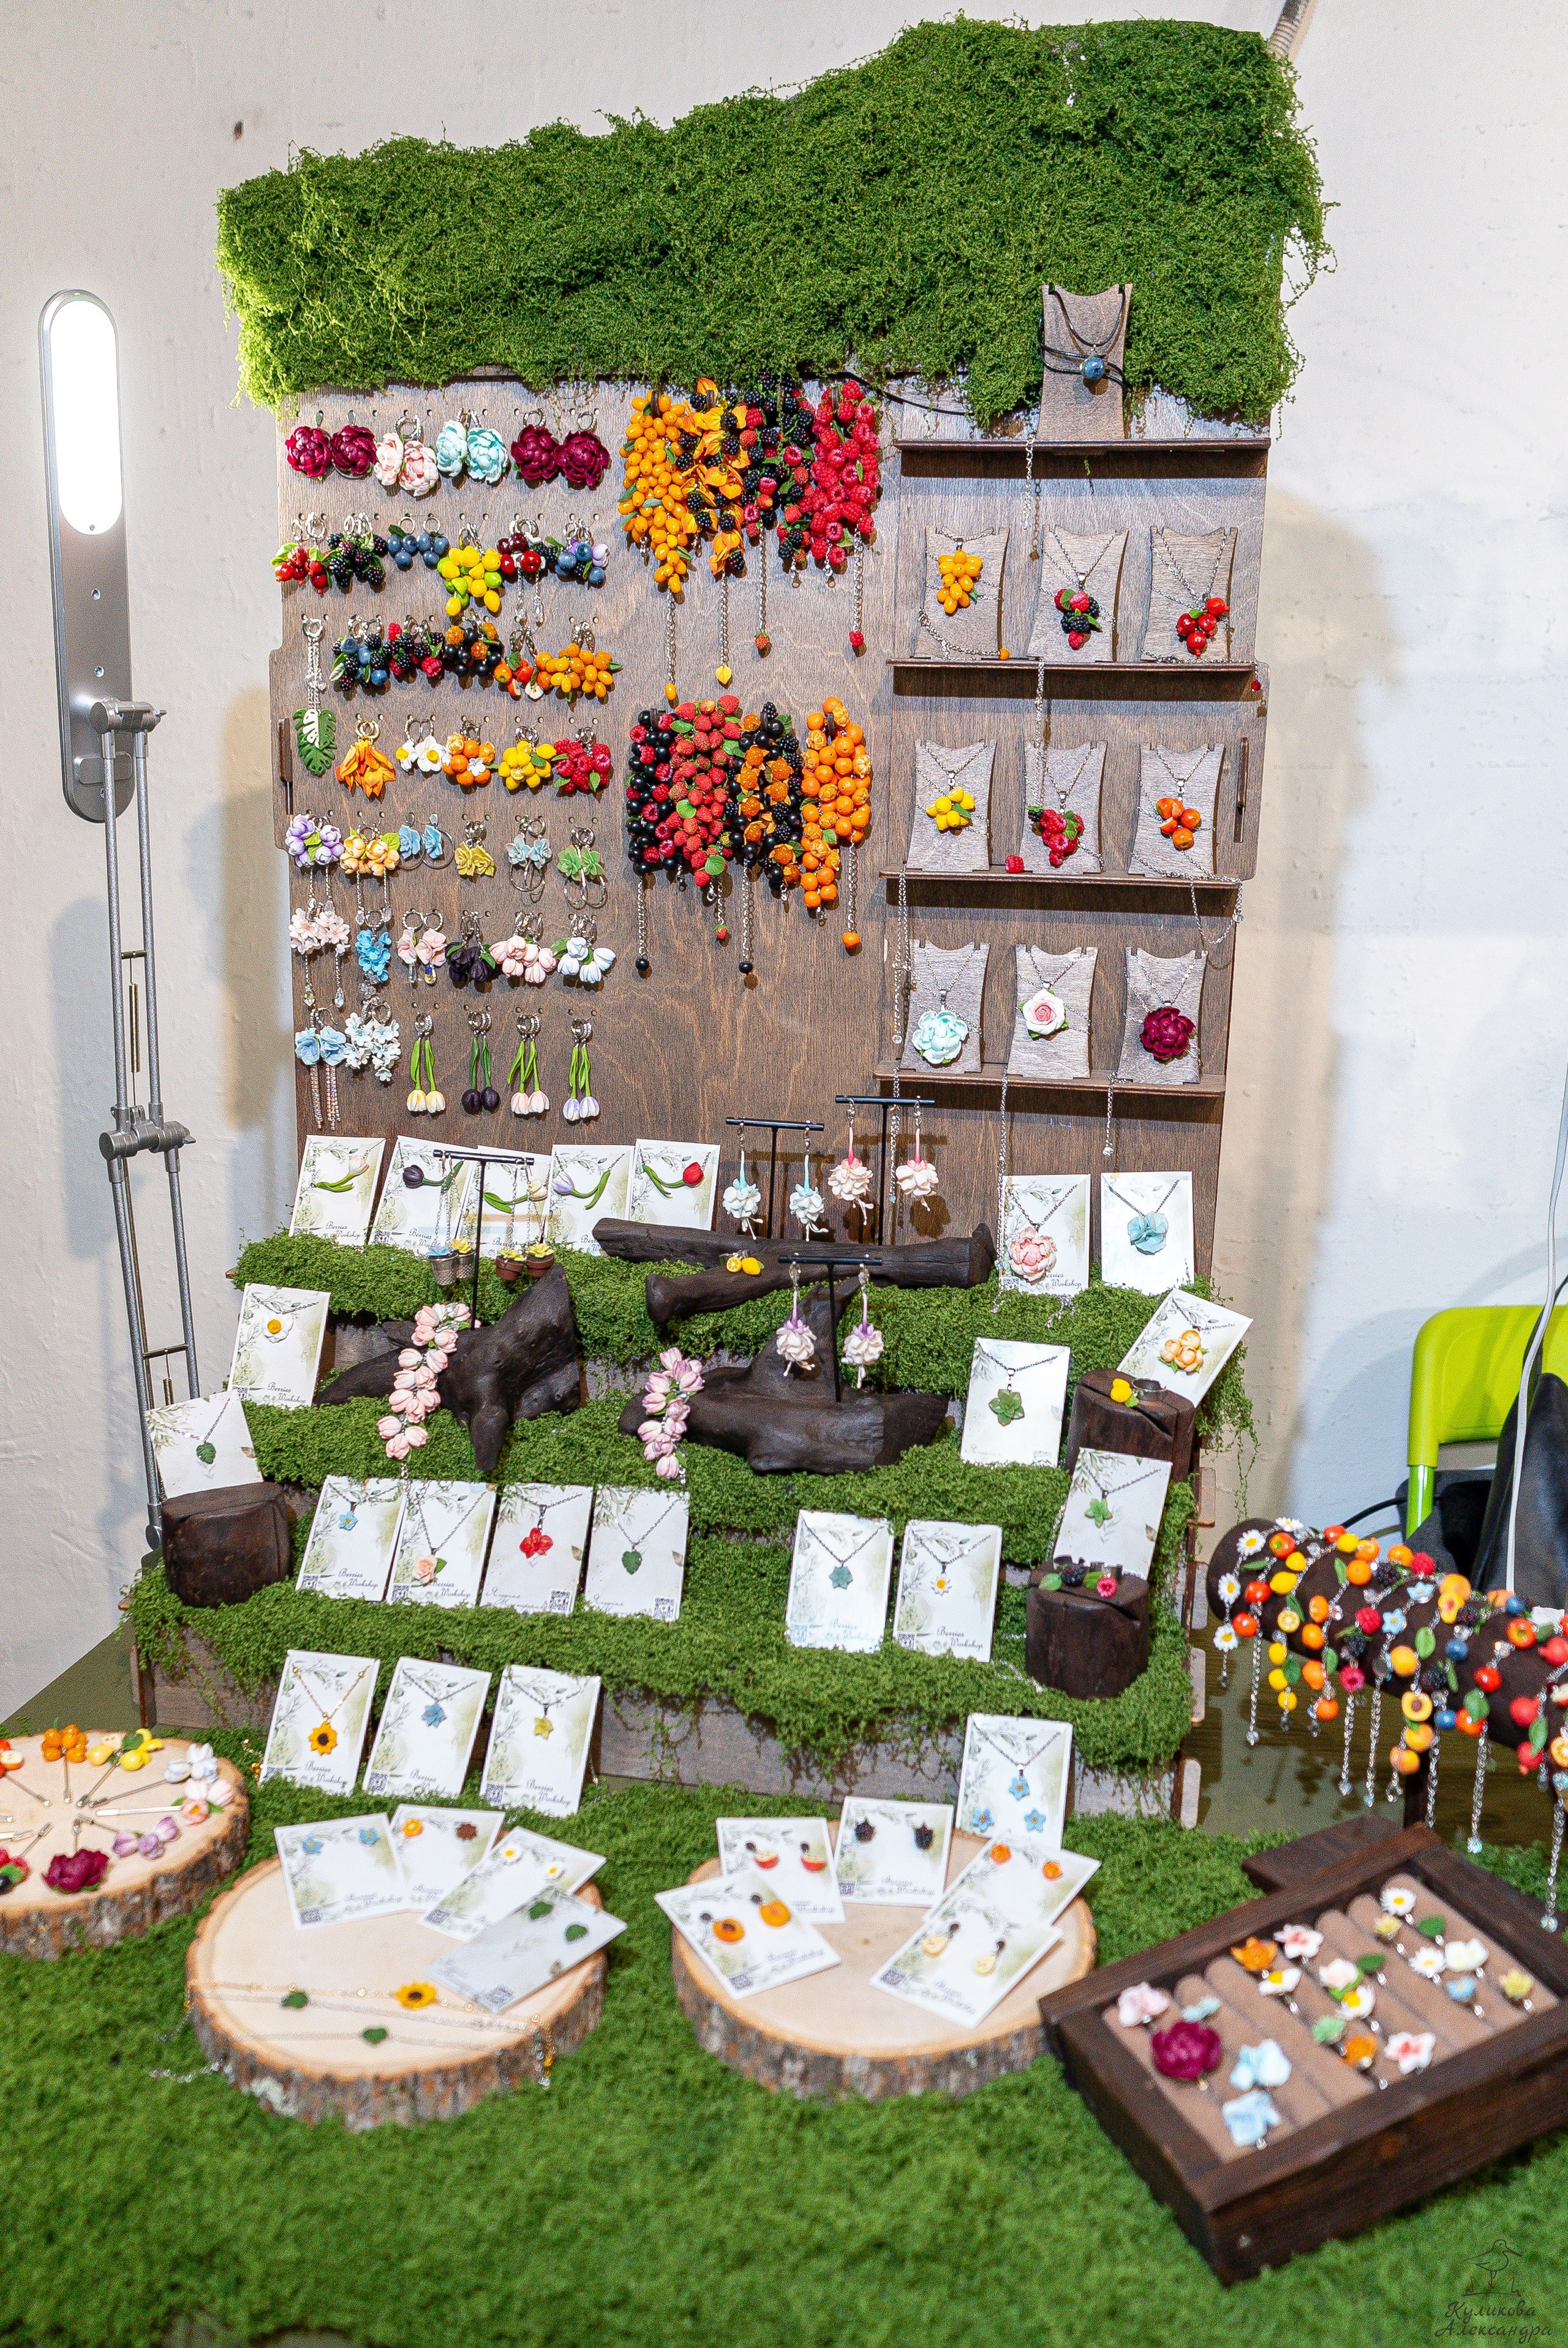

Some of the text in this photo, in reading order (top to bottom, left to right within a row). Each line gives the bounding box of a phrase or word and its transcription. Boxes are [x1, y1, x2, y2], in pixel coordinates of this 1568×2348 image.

[326, 1221, 347, 1229] Berries
[409, 1228, 432, 1239] Berries
[1051, 1278, 1082, 1289] Workshop
[268, 1382, 292, 1392] Berries
[278, 1392, 306, 1403] Workshop
[338, 1568, 363, 1577] Berries
[349, 1578, 379, 1590] Workshop
[441, 1587, 471, 1600] Workshop
[937, 1625, 964, 1637] Berries
[950, 1637, 983, 1652] Workshop
